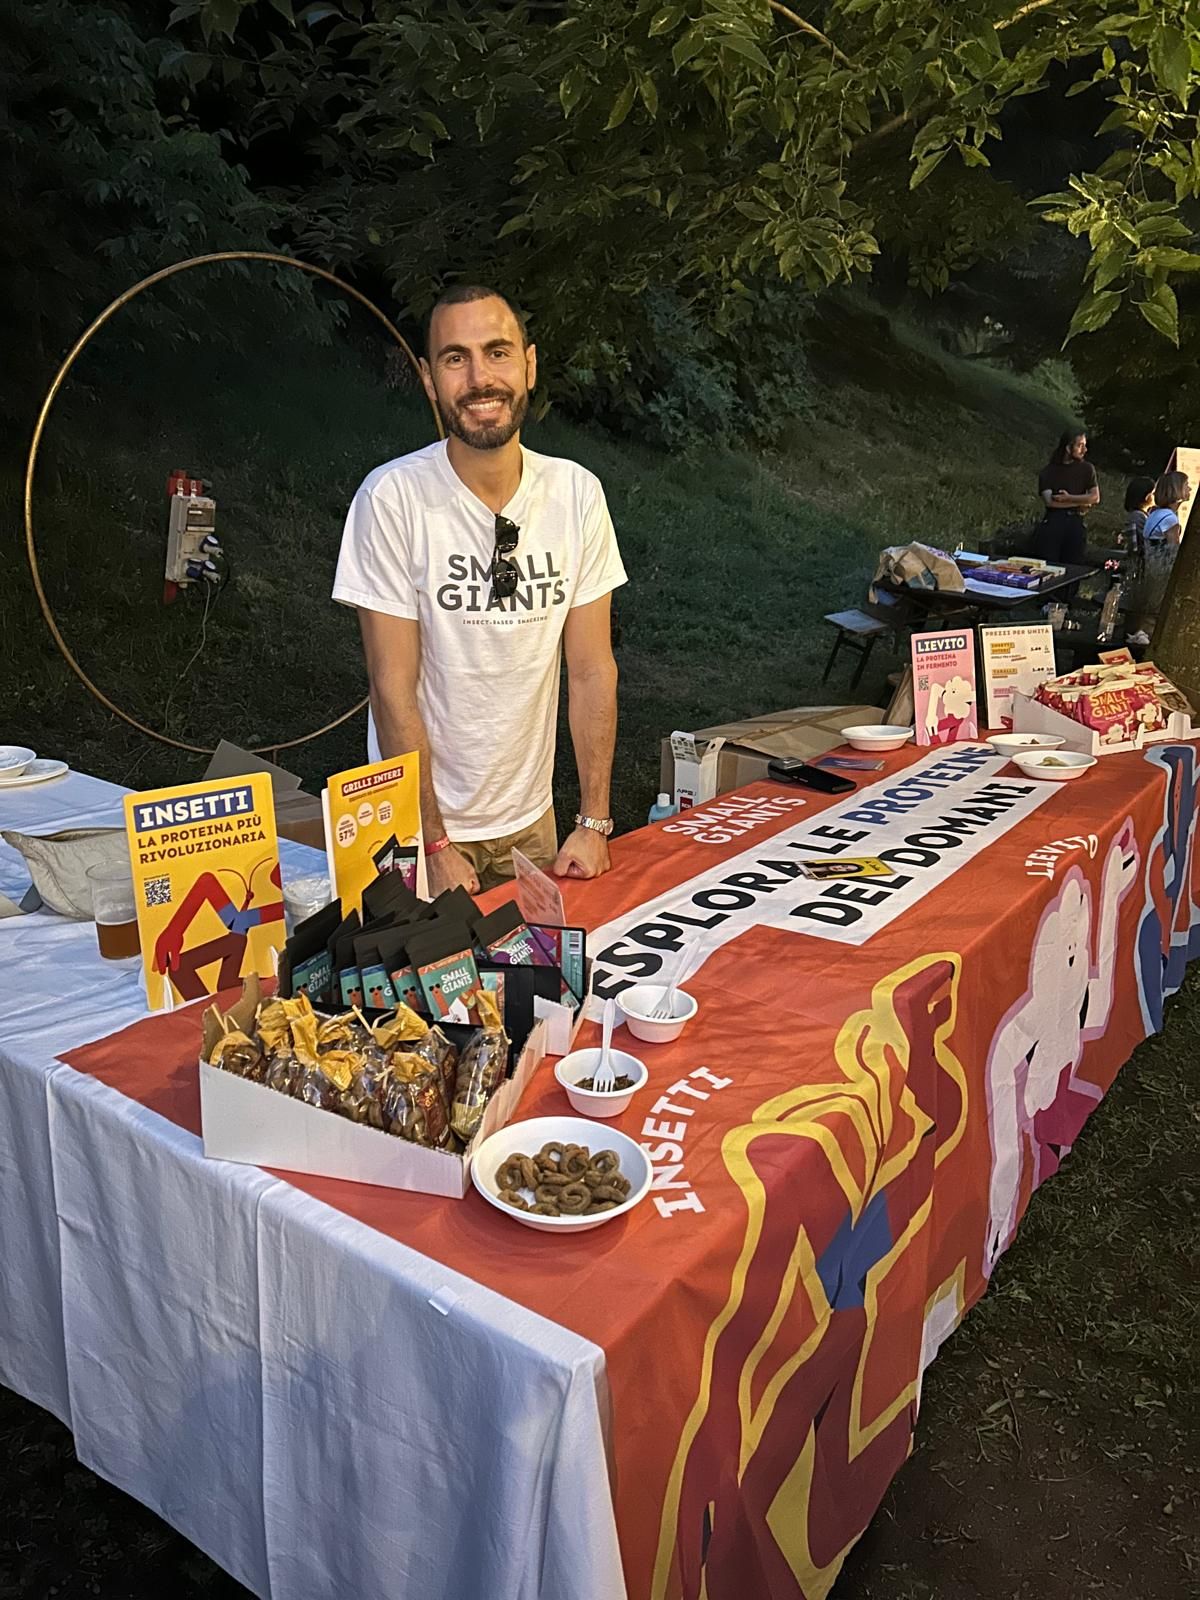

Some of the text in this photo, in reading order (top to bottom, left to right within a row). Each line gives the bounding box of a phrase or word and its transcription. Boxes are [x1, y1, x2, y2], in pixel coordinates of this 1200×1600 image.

[437, 579, 566, 612] GIANTS
[917, 637, 965, 653] LIEVITO
[926, 653, 957, 662] PROTEINA
[343, 777, 372, 794] GRILLI
[373, 768, 402, 785] INTERI
[139, 790, 249, 828] INSETTI
[662, 796, 769, 835] SMALL
[693, 797, 807, 844] GIANTS
[138, 814, 262, 849] LA PROTEINA PIÙ
[140, 831, 266, 864] RIVOLUZIONARIA
[339, 828, 355, 842] 57%
[789, 783, 1038, 927] DEL DOMANI
[1025, 834, 1098, 881] LIEVITO
[592, 859, 802, 1000] ESPLORA
[787, 825, 872, 855] LE
[506, 939, 528, 956] SMALL
[509, 945, 534, 965] GIANTS
[441, 966, 470, 984] SMALL
[442, 975, 473, 994] GIANTS
[641, 1066, 733, 1218] INSETTI
